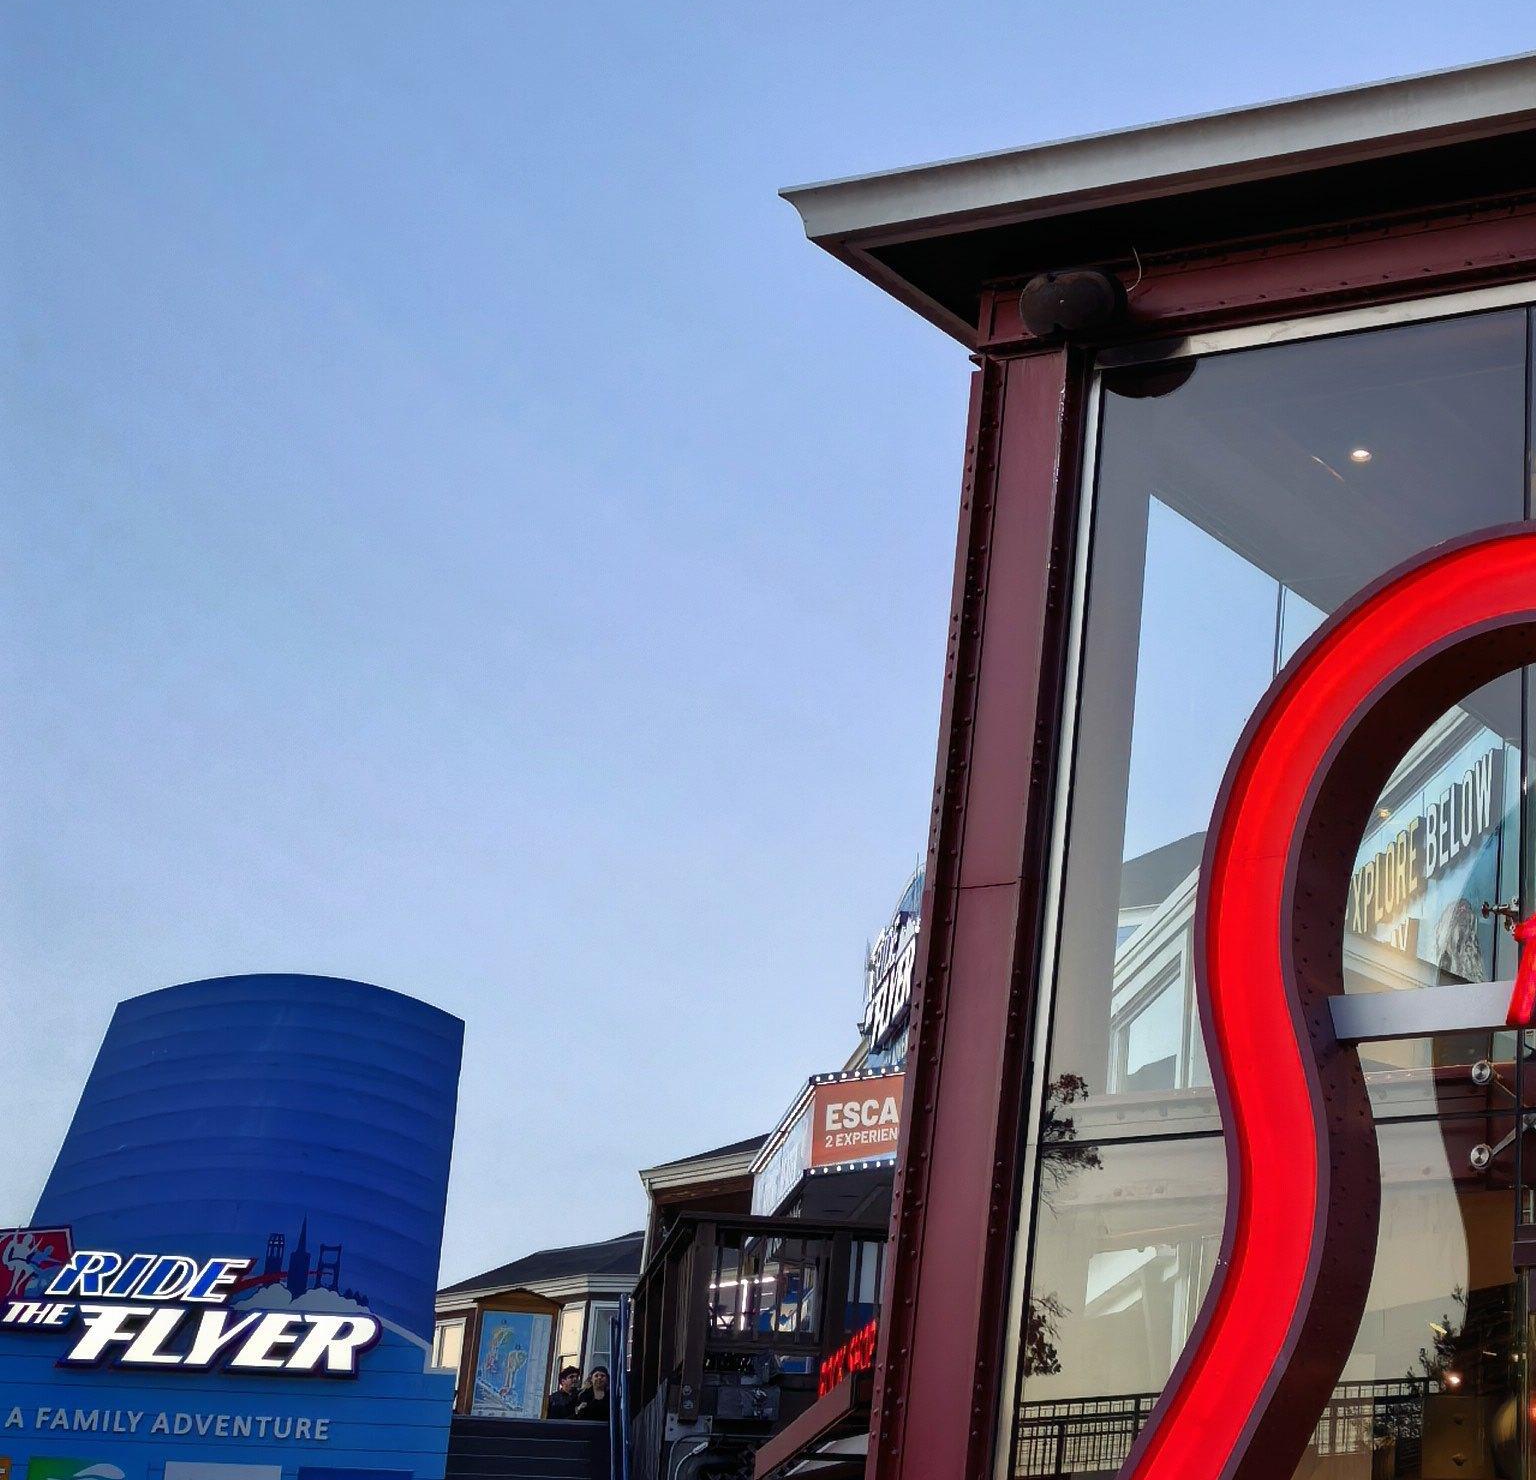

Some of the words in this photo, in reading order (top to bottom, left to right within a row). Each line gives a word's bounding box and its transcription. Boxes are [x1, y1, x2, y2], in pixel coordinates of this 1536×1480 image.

[1352, 816, 1420, 934] XPLORE
[1426, 748, 1494, 879] BELOW
[825, 1097, 899, 1131] ESCA
[825, 1135, 833, 1148] 2
[835, 1127, 898, 1147] EXPERIEN
[45, 1250, 251, 1303] RIDE
[2, 1301, 75, 1325] THE
[67, 1304, 377, 1371] FLYER
[5, 1407, 24, 1429] A
[35, 1408, 144, 1433] FAMILY
[150, 1411, 330, 1441] ADVENTURE
